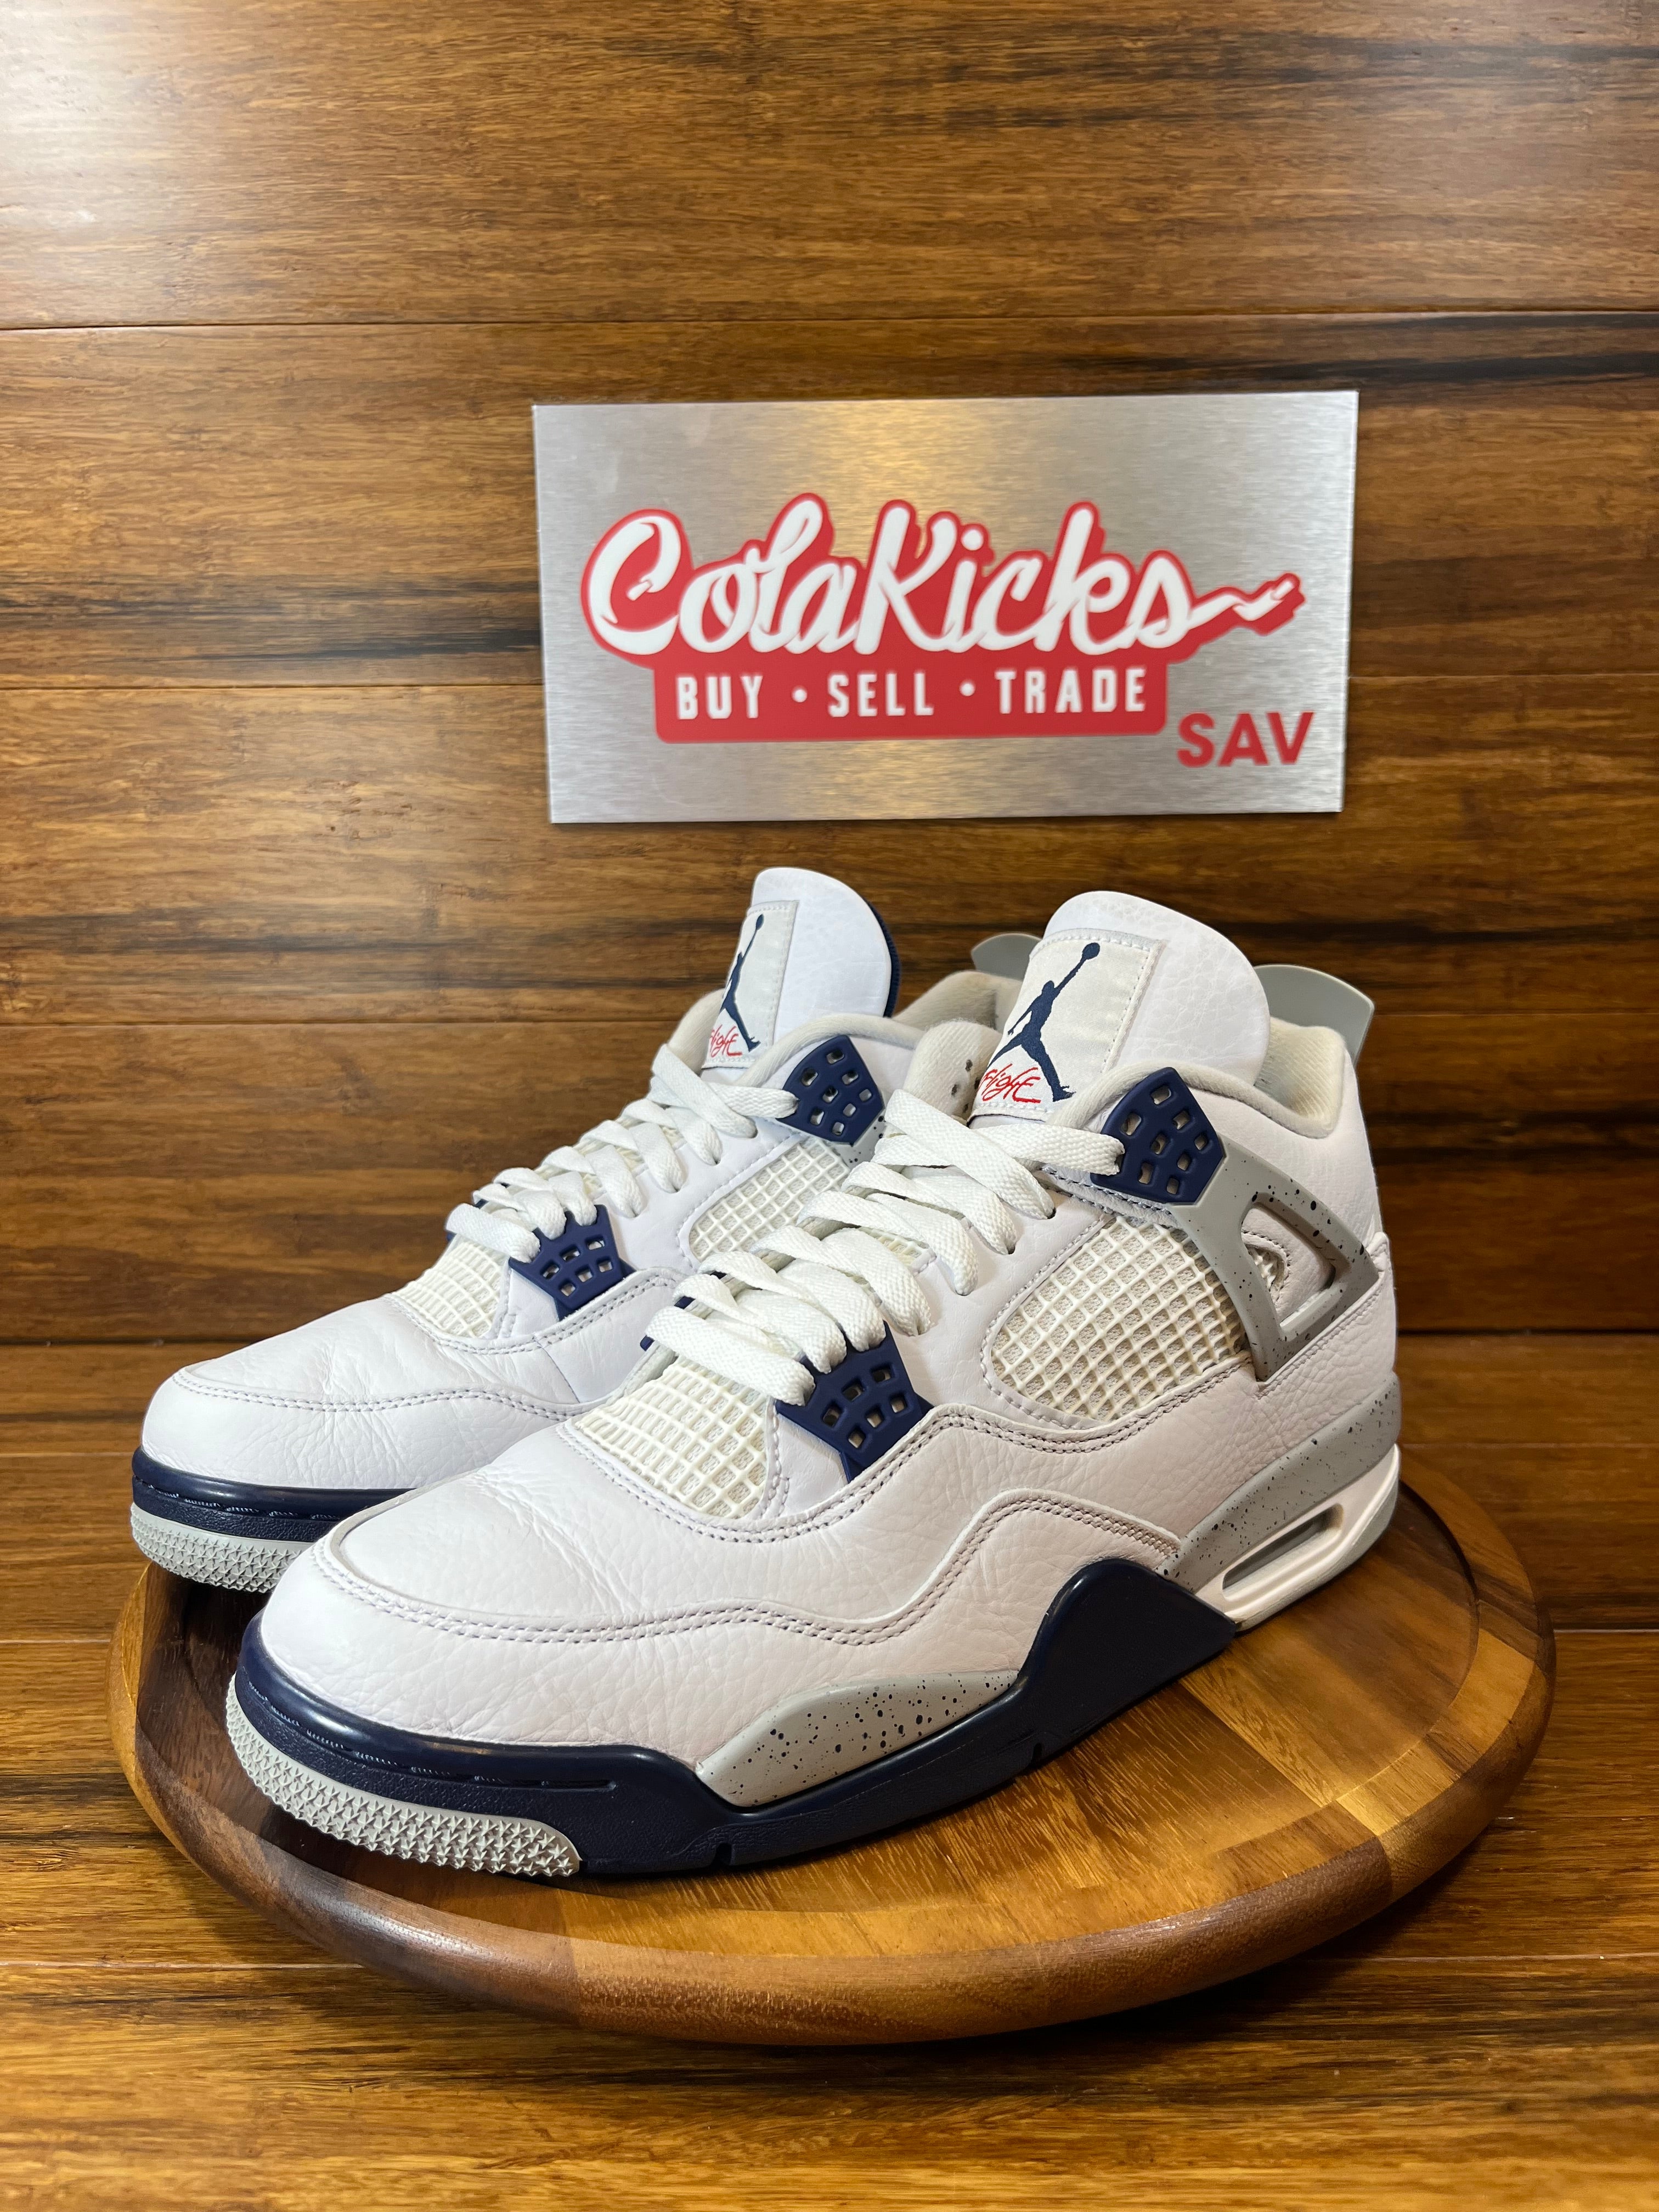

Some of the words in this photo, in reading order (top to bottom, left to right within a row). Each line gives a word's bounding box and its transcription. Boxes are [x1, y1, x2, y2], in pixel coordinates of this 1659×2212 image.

[589, 498, 1295, 656] ColaKicks
[675, 674, 763, 720] BUY
[828, 672, 934, 718] SELL
[995, 668, 1146, 715] TRADE
[1177, 711, 1315, 768] SAV
